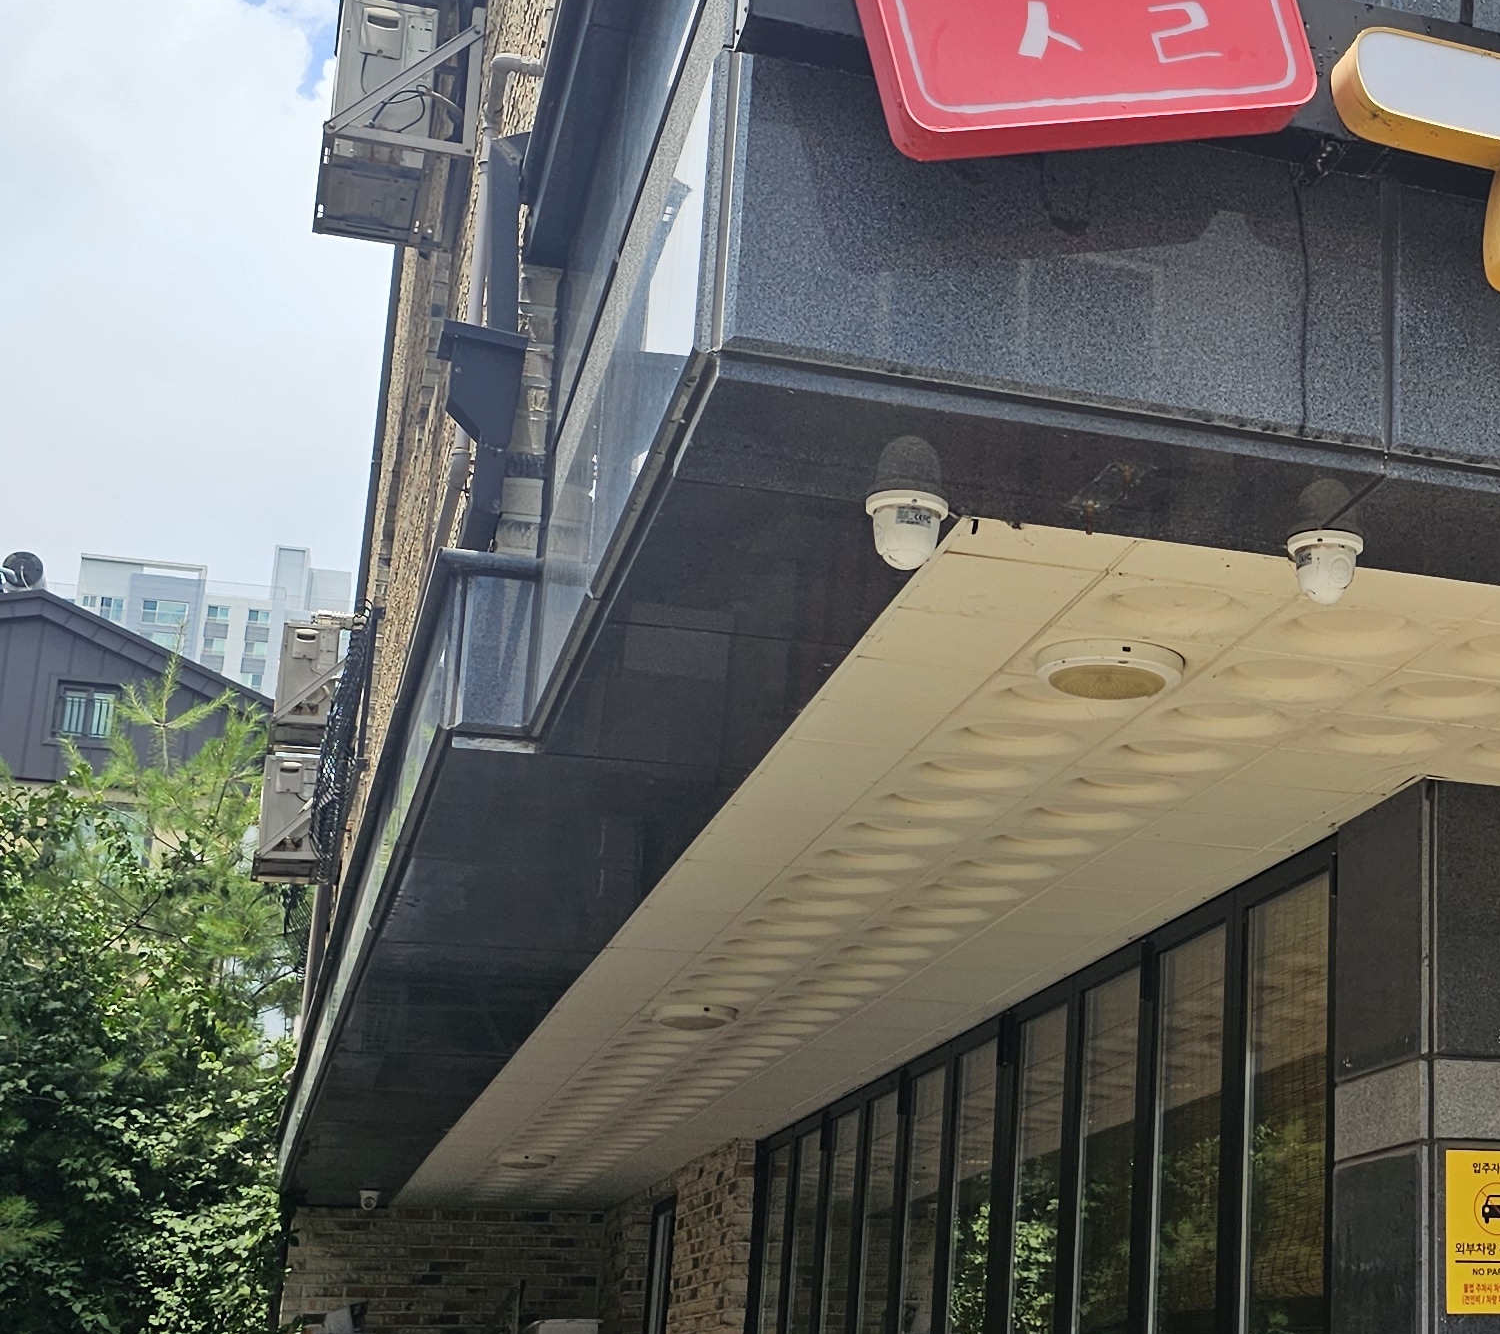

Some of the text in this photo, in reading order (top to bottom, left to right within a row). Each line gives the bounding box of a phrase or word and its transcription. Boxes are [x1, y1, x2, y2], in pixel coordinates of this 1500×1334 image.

[1472, 1162, 1500, 1174] 입주자
[1455, 1242, 1497, 1255] 외부차량
[1472, 1268, 1485, 1276] NO
